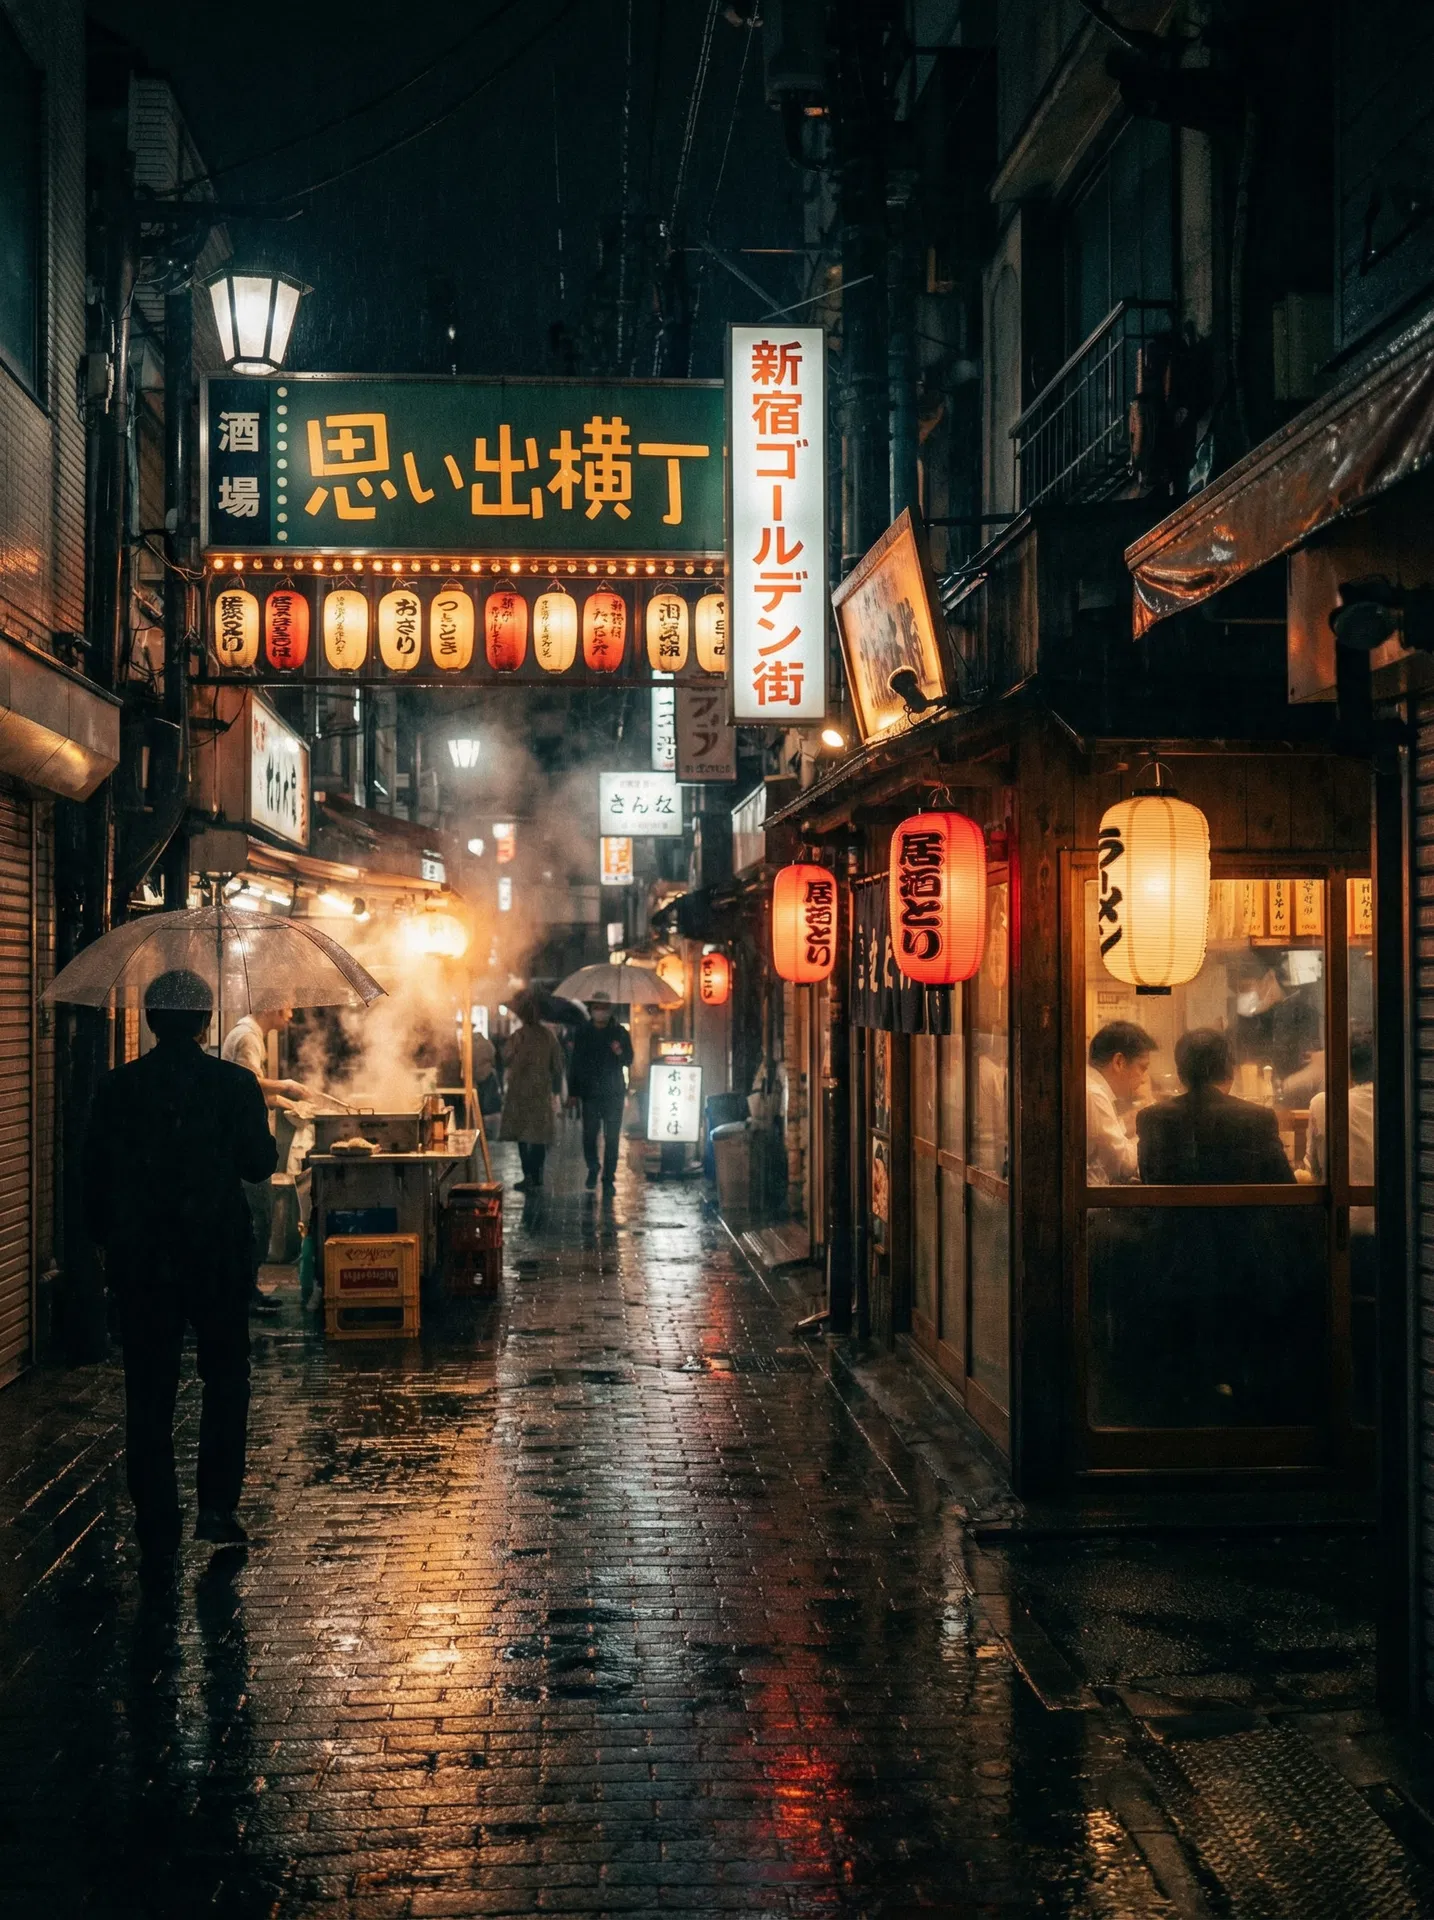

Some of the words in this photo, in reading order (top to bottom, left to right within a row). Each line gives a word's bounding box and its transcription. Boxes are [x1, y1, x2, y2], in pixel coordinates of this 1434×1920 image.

[218, 411, 261, 518] 酒場
[304, 413, 710, 525] 思い出横丁
[752, 339, 809, 706] 新宿ゴールデン街
[1098, 827, 1126, 958] ラーメン
